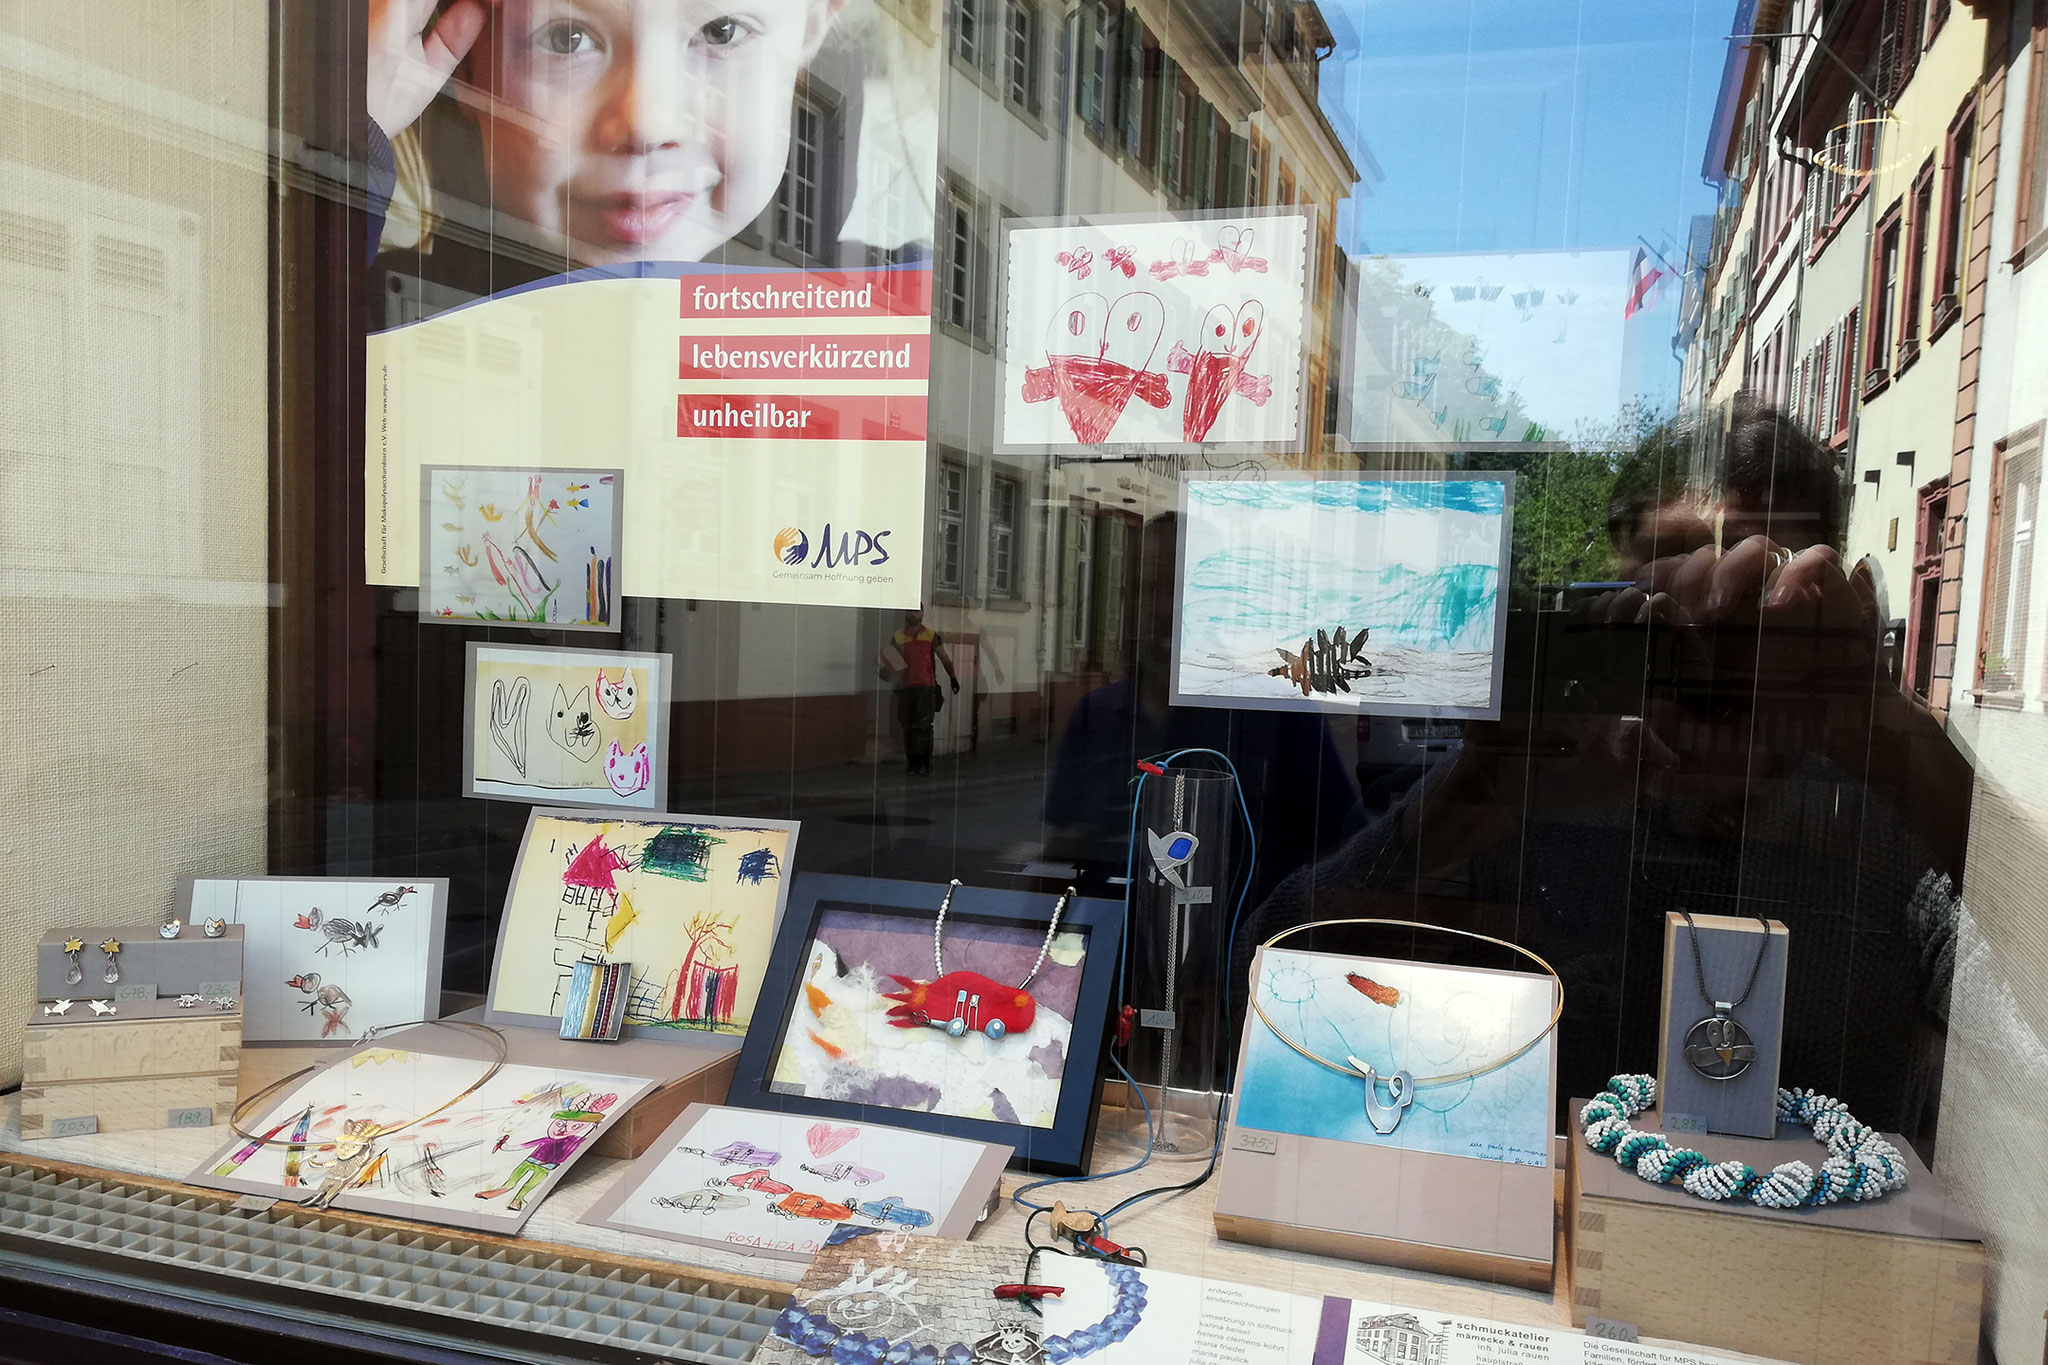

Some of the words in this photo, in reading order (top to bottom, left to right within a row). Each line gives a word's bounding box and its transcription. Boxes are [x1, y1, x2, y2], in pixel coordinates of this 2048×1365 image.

[693, 283, 871, 310] fortschreitend
[693, 343, 911, 369] lebensverkürzend
[693, 403, 811, 428] unheilbar
[811, 523, 891, 569] MPS
[773, 570, 822, 580] Gemeinsam
[824, 573, 865, 584] Hoffnung
[866, 574, 893, 584] geben
[1240, 1135, 1274, 1150] 375,-
[1206, 1295, 1281, 1313] kinderzeichnungen
[1200, 1321, 1224, 1331] karina
[1201, 1312, 1246, 1326] umsetzung
[1196, 1330, 1224, 1341] helena
[1226, 1336, 1285, 1352] clemens-kohrt
[1456, 1322, 1550, 1343] schmuckatelier
[1194, 1339, 1218, 1349] maria
[1220, 1343, 1246, 1354] friedel
[1498, 1347, 1518, 1356] julia
[1522, 1352, 1550, 1361] rauen
[1519, 1342, 1549, 1353] rauen
[1584, 1341, 1598, 1350] Die
[1601, 1344, 1657, 1360] Gesellschaft
[1659, 1353, 1672, 1362] für
